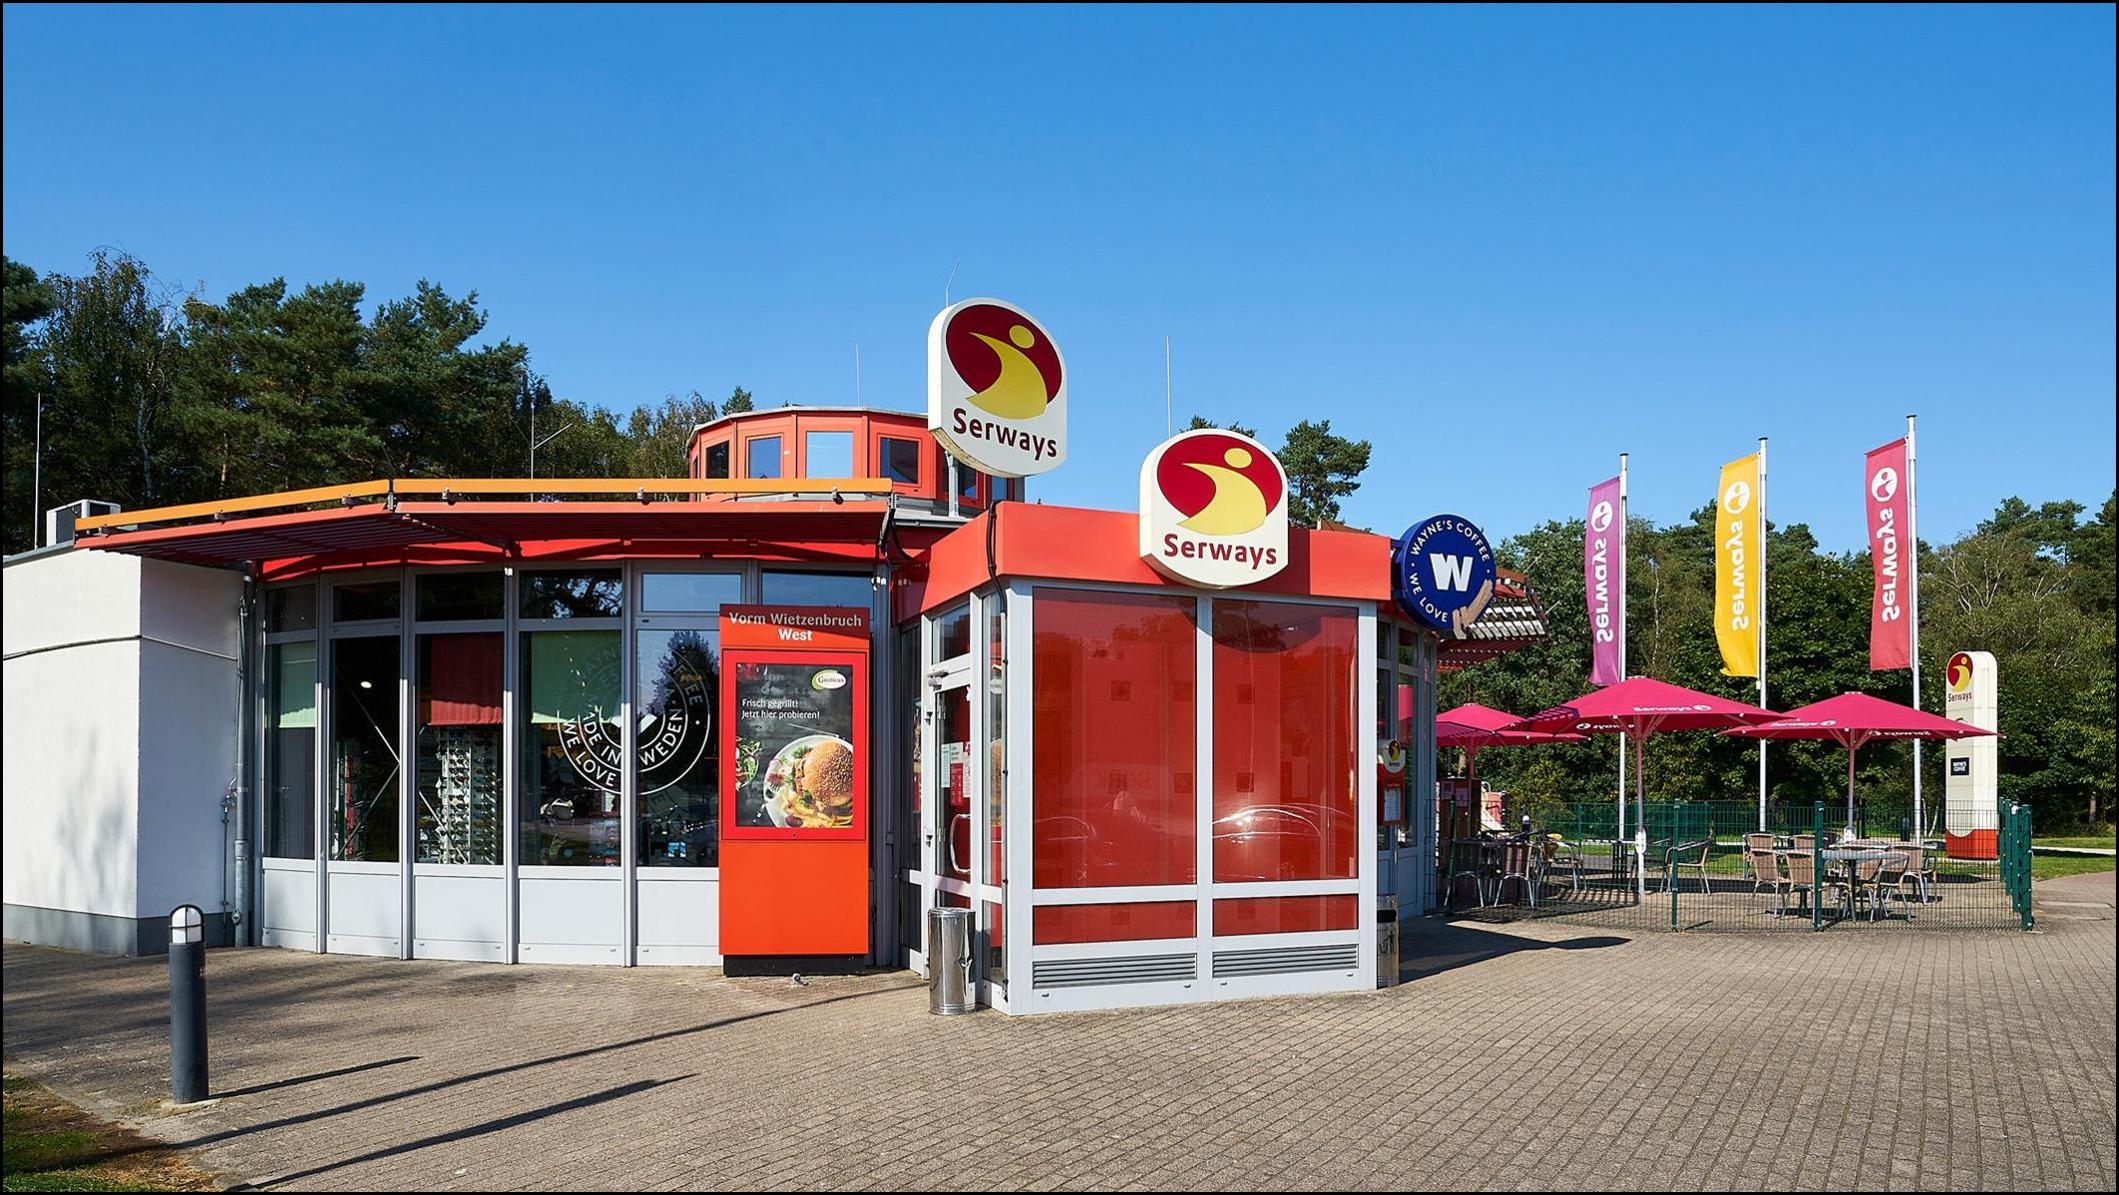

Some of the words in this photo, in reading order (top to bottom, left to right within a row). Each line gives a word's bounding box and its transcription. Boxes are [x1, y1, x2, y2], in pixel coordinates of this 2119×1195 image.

[953, 407, 1057, 461] Serways
[1163, 533, 1277, 570] Serways
[1411, 520, 1453, 556] WAYNE'S
[1456, 522, 1490, 562] COFFEE
[1429, 552, 1474, 592] W
[1409, 572, 1423, 596] WE
[1419, 597, 1448, 623] LOVE
[729, 612, 766, 625] Vorm
[770, 613, 862, 627] Wietzenbruch
[778, 628, 813, 641] West
[741, 710, 760, 720] Jetzt
[761, 710, 777, 719] hier
[778, 710, 820, 720] probieren!
[742, 699, 766, 708] Frisch
[767, 699, 798, 709] gegrillt!
[563, 717, 581, 749] WE
[575, 751, 617, 788] LOVE
[600, 745, 622, 766] IN
[638, 708, 684, 766] WEDEN
